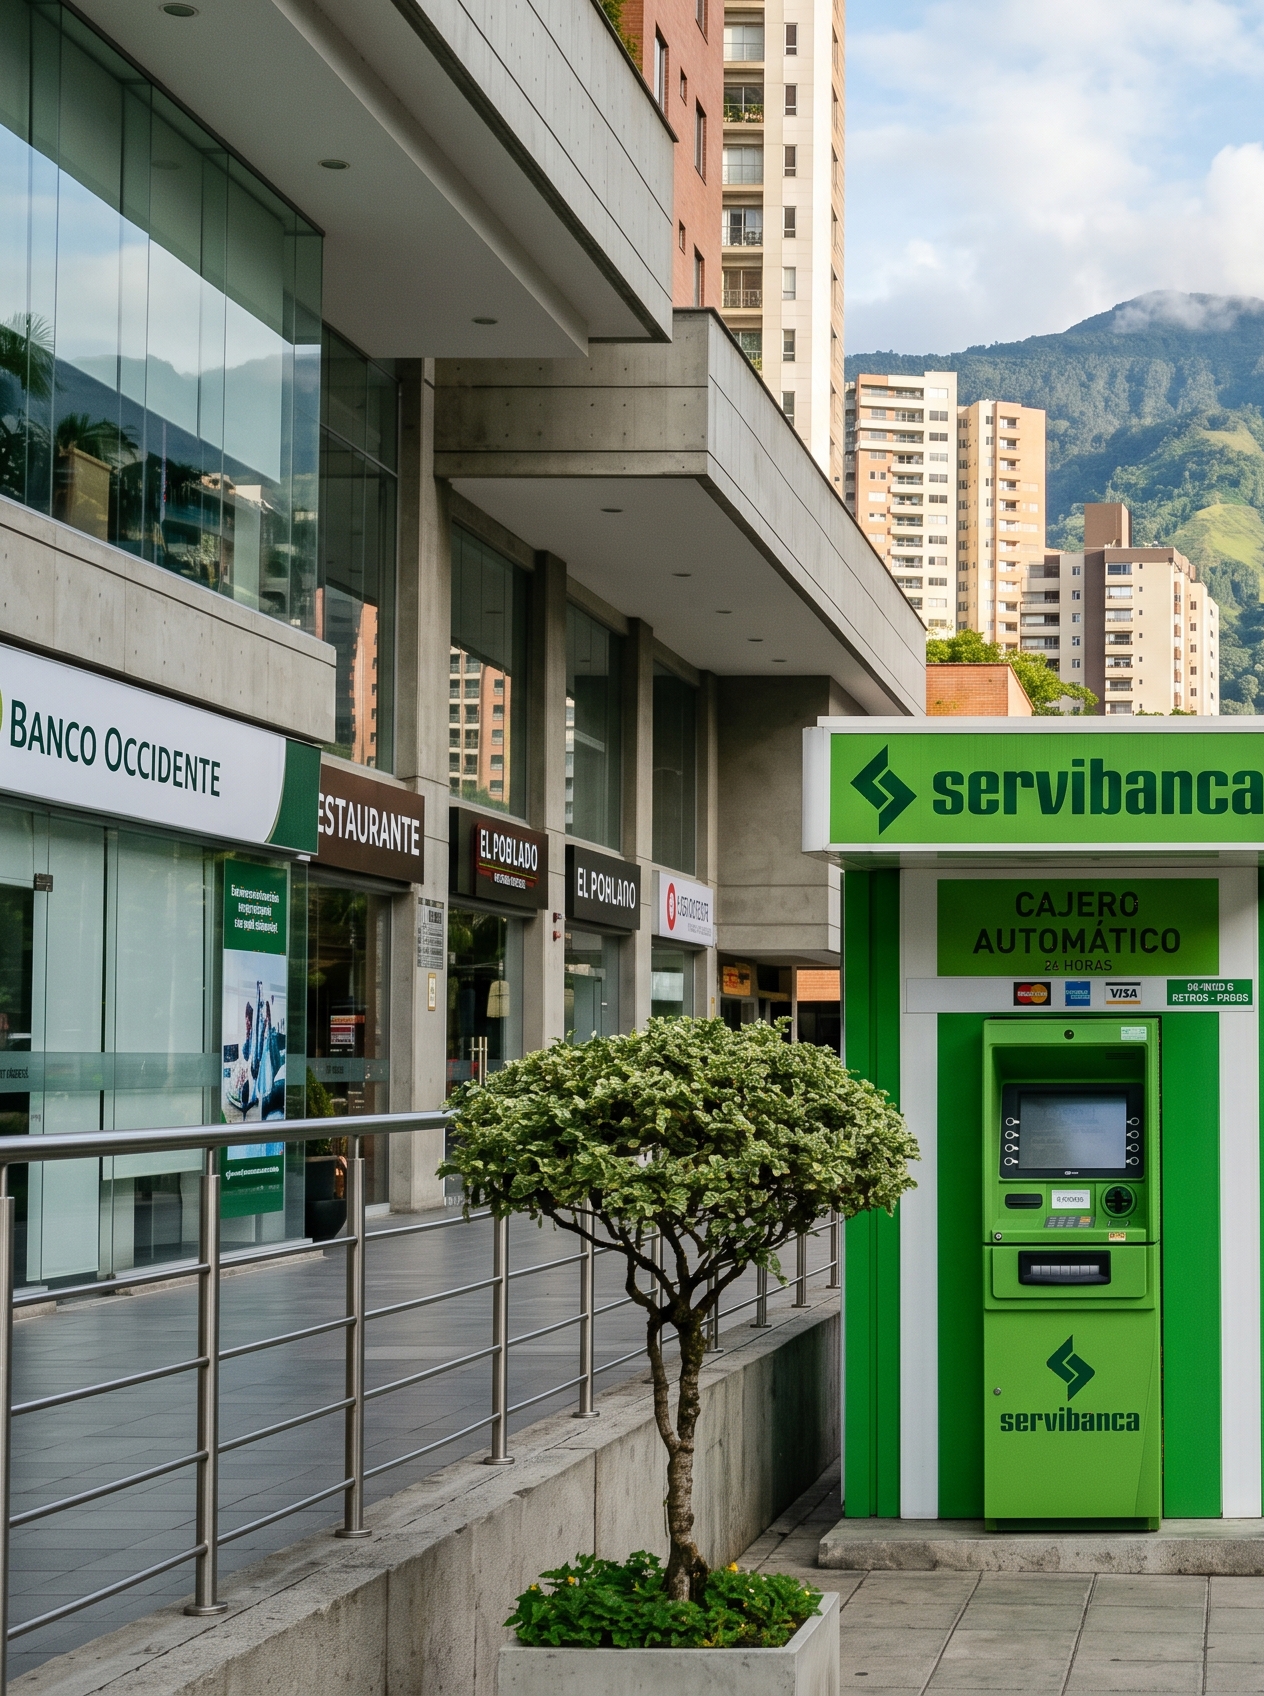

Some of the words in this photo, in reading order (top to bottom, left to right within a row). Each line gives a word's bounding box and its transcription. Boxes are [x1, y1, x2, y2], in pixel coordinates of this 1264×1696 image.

[10, 699, 97, 766] BANCO
[104, 727, 221, 797] OCCIDENTE
[932, 758, 1264, 816] servibanca
[318, 792, 420, 856] ESTAURANTE
[480, 828, 491, 859] EL
[493, 832, 538, 871] POBLADO
[577, 867, 588, 898] EL
[1015, 891, 1139, 917] CAJERO
[972, 919, 1181, 954] AUTOMÁTICO
[1064, 959, 1112, 971] HORAS
[1110, 988, 1138, 998] VISA
[1172, 993, 1209, 1002] RETROS
[1000, 1407, 1140, 1432] servibanca
